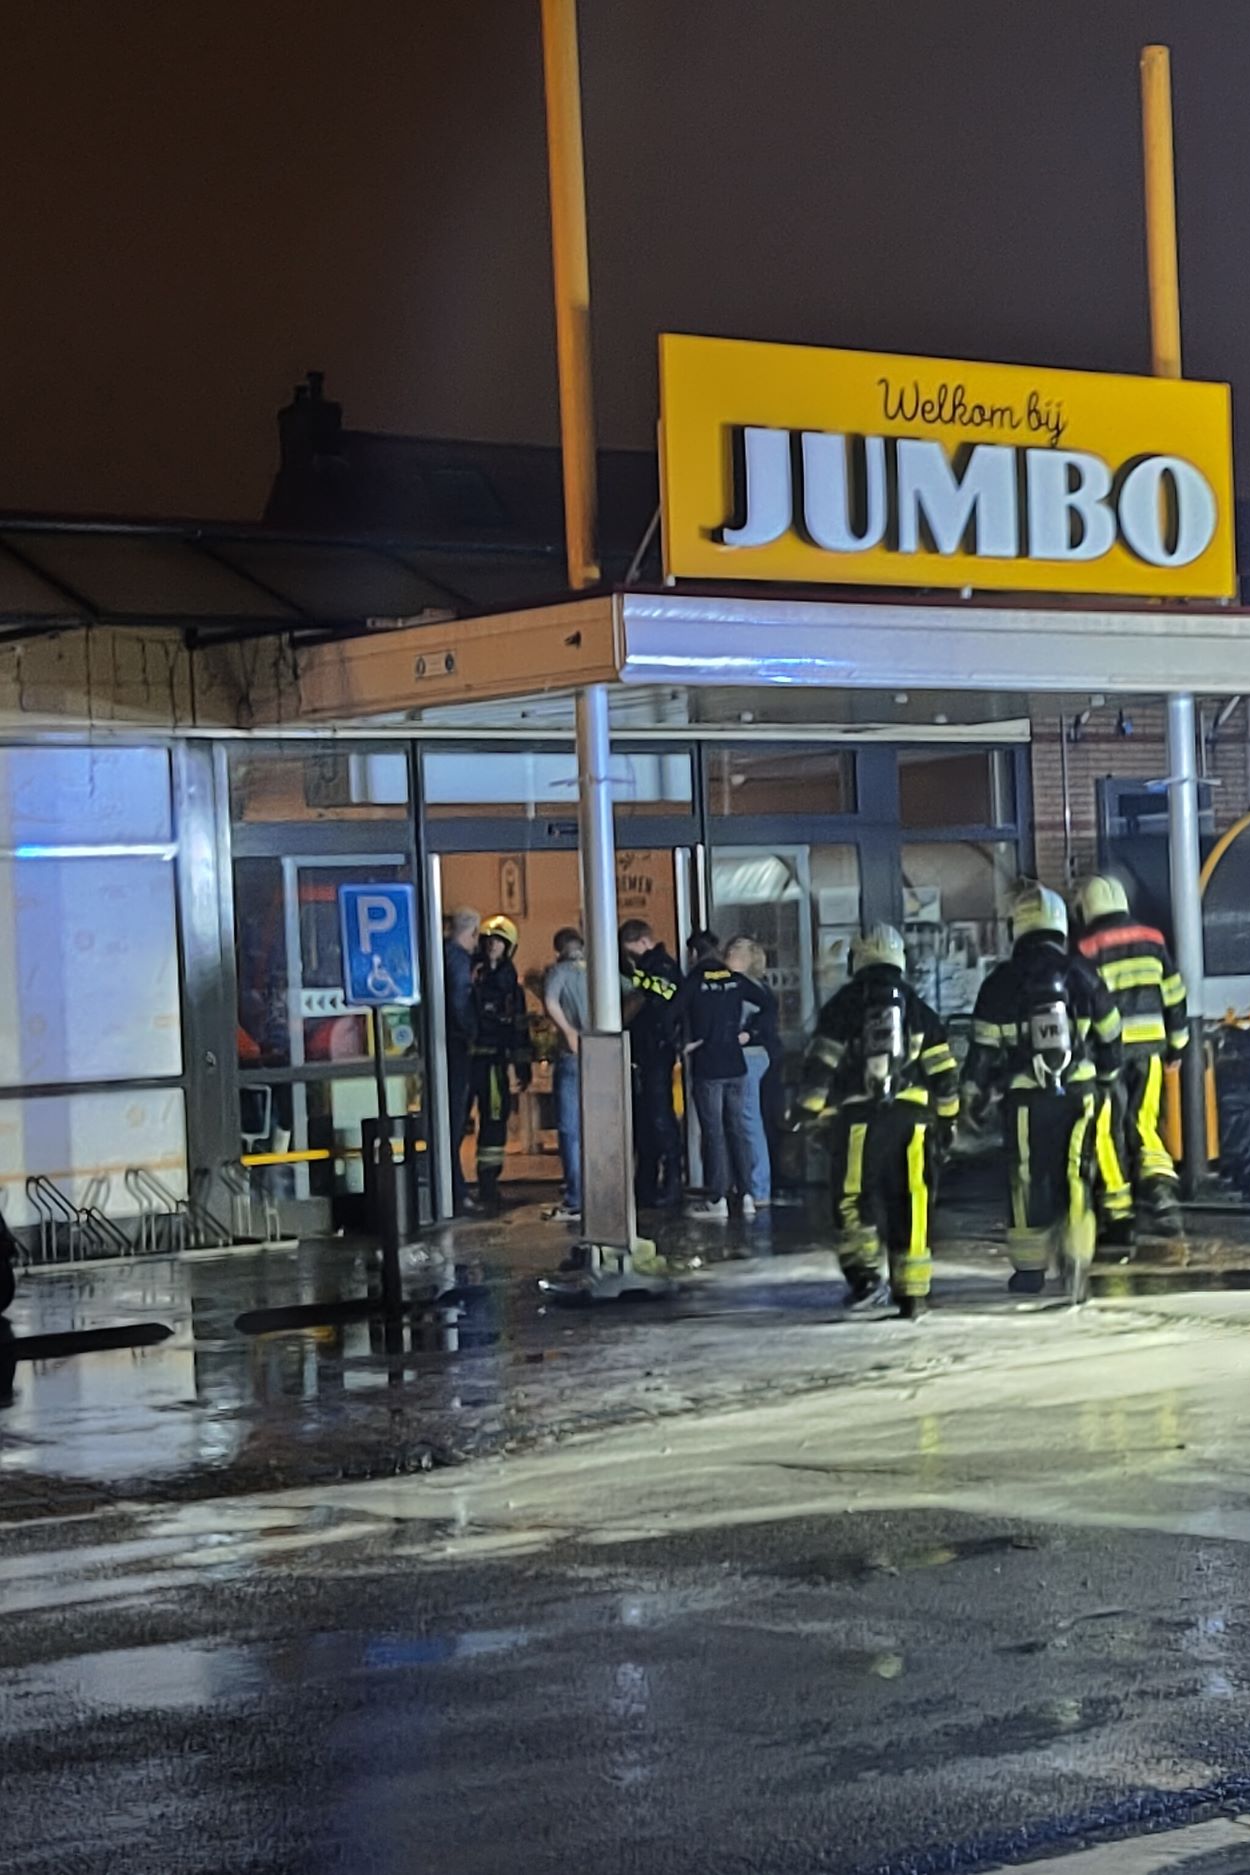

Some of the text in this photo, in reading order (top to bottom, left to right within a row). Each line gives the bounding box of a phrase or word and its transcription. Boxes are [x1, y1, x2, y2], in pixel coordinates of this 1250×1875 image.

[876, 377, 1068, 446] Welkom bij
[717, 424, 1218, 568] JUMBO
[357, 895, 398, 955] P
